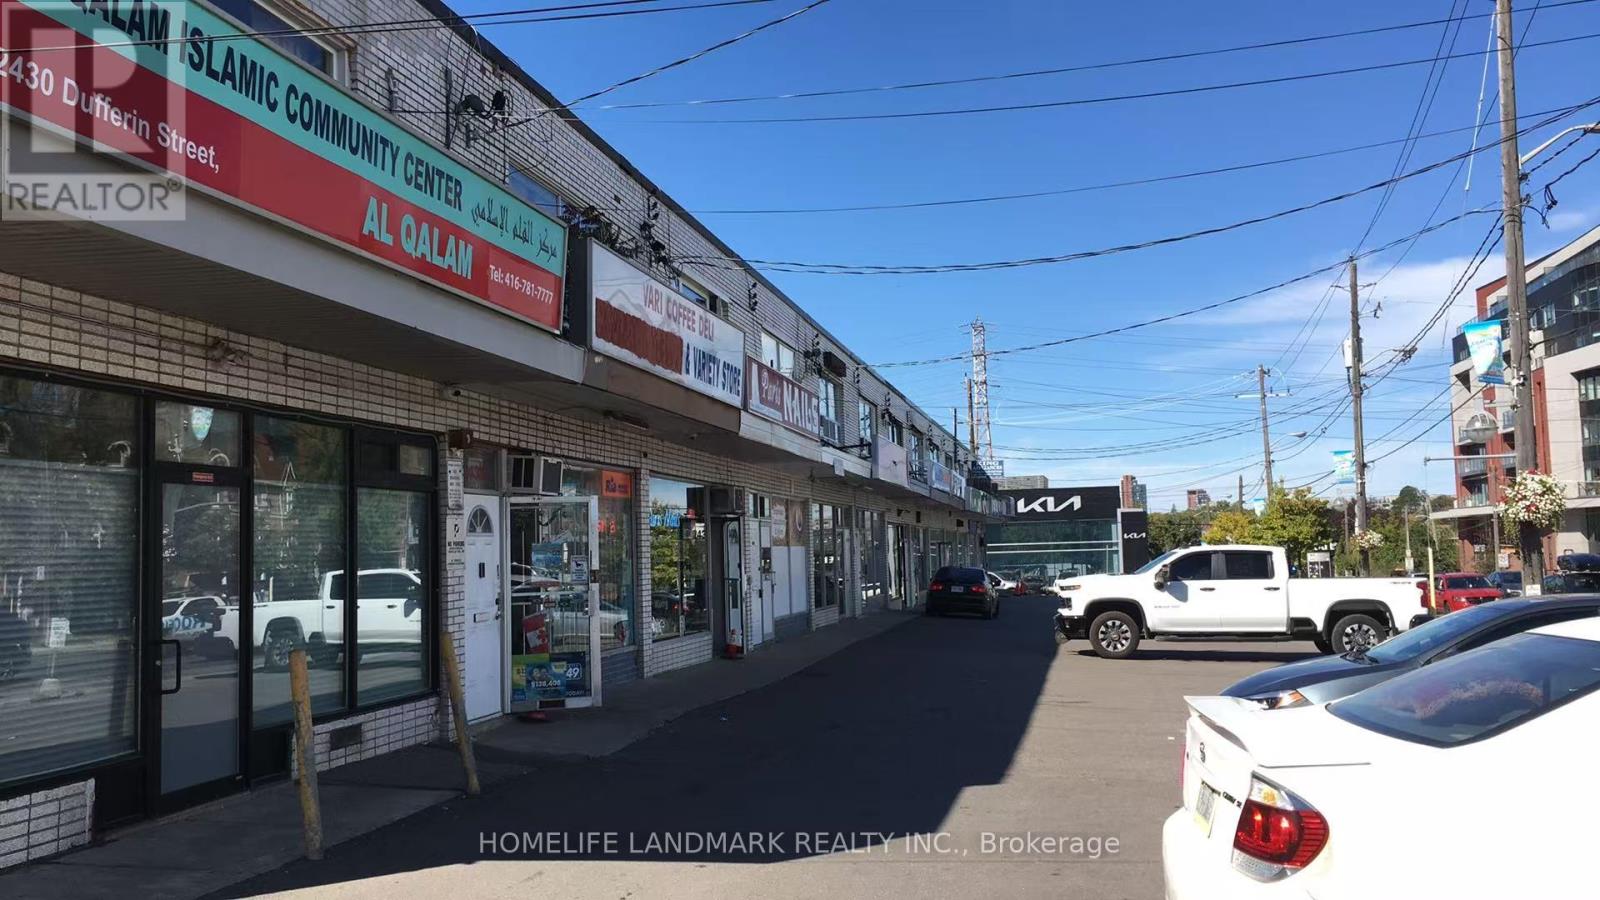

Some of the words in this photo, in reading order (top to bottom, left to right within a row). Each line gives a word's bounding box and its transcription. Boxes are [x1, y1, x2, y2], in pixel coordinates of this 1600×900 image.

[62, 77, 151, 140] Dufferin
[156, 121, 219, 173] Street,
[70, 0, 171, 56] ALAM
[179, 21, 279, 113] ISLAMIC
[285, 84, 400, 178] COMMUNITY
[403, 151, 463, 211] CENTER
[362, 196, 394, 247] AL
[400, 213, 473, 280] QALAM
[513, 214, 533, 245] القلم
[536, 227, 557, 263] مركز
[489, 264, 503, 284] Tel:
[505, 273, 553, 305] 416-781-7777
[665, 295, 696, 333] COFFEE
[699, 314, 715, 342] DELI
[685, 342, 690, 375] &
[693, 346, 720, 388] VARIETY
[722, 361, 741, 397] STORE
[783, 380, 819, 434] NAILS
[1017, 495, 1081, 513] KIA
[566, 667, 579, 678] 49
